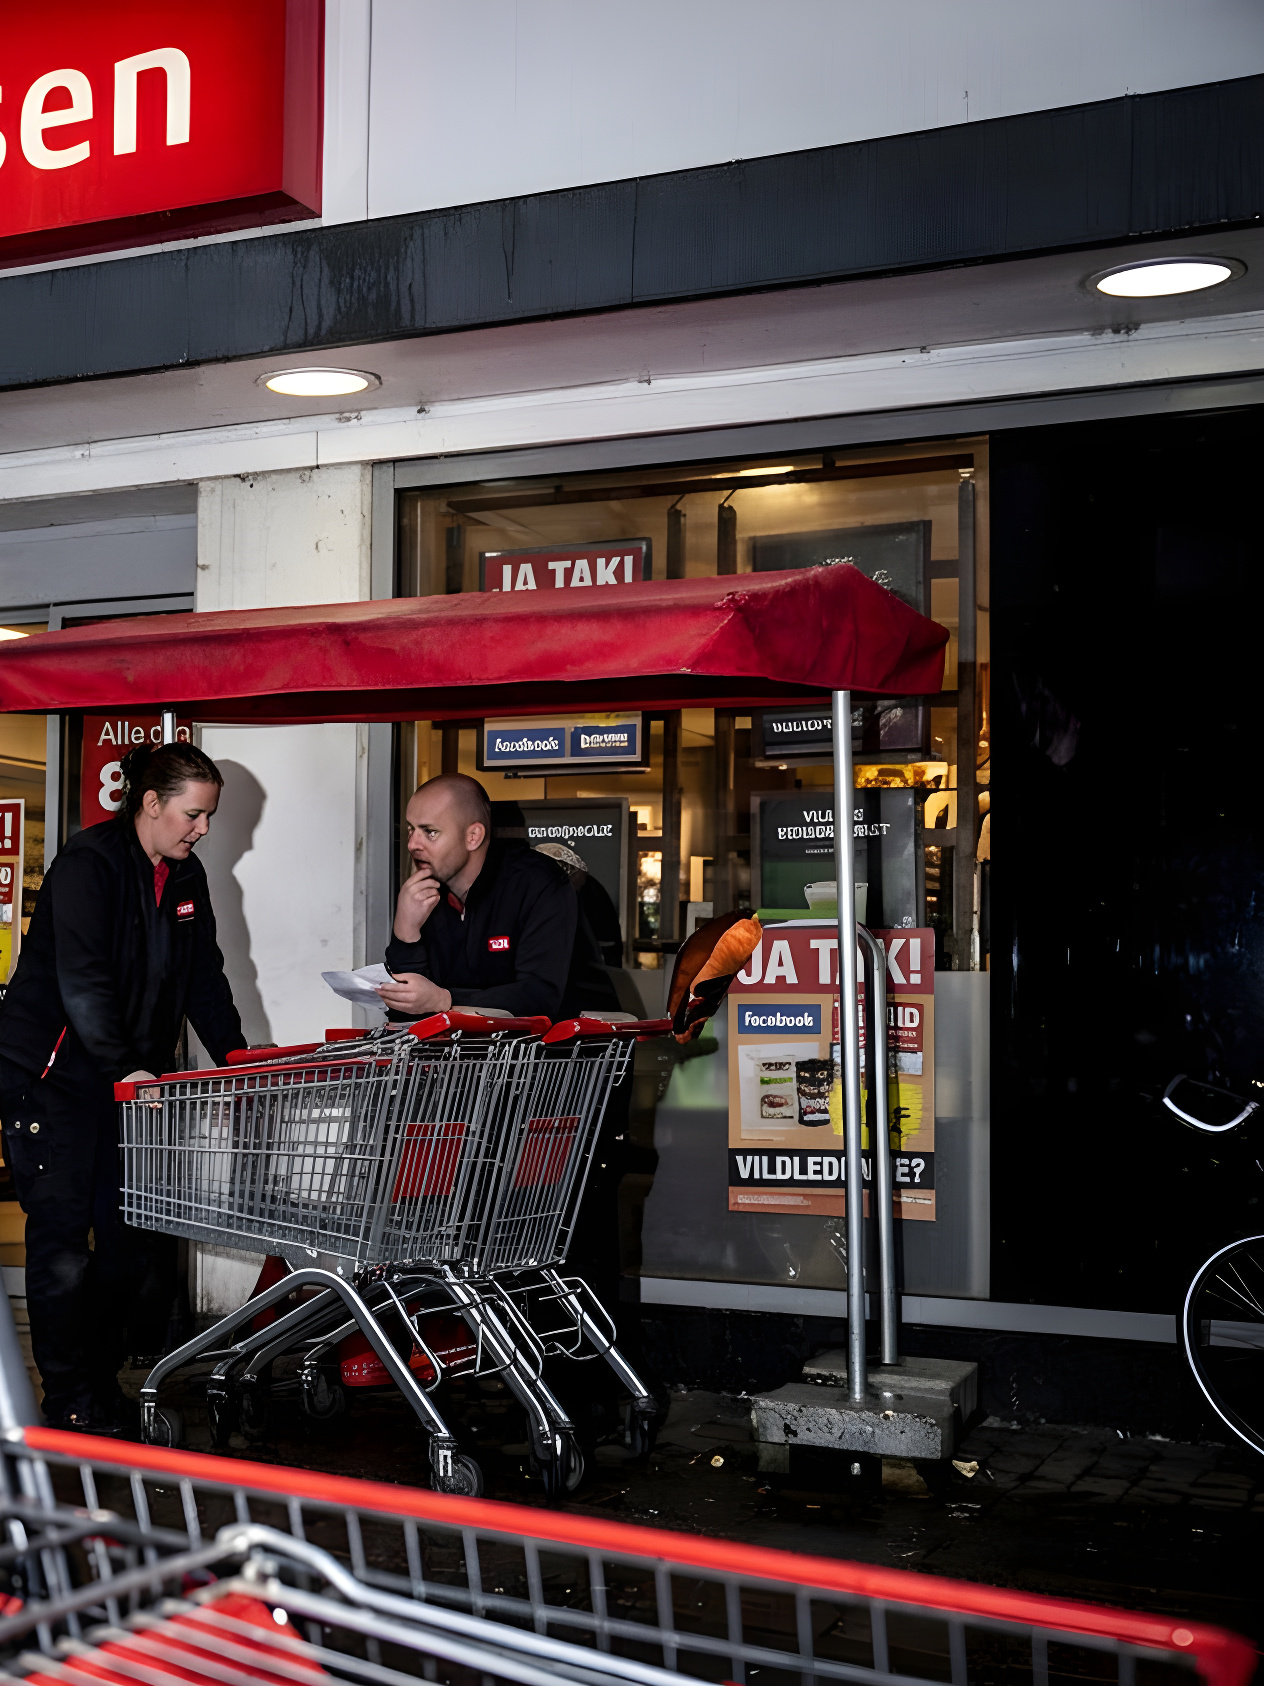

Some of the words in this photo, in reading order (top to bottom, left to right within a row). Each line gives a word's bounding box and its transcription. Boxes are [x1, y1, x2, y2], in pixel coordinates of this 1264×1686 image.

[492, 563, 537, 592] JA
[97, 721, 144, 746] Alle
[737, 938, 798, 985] JA
[810, 938, 922, 985] TK!
